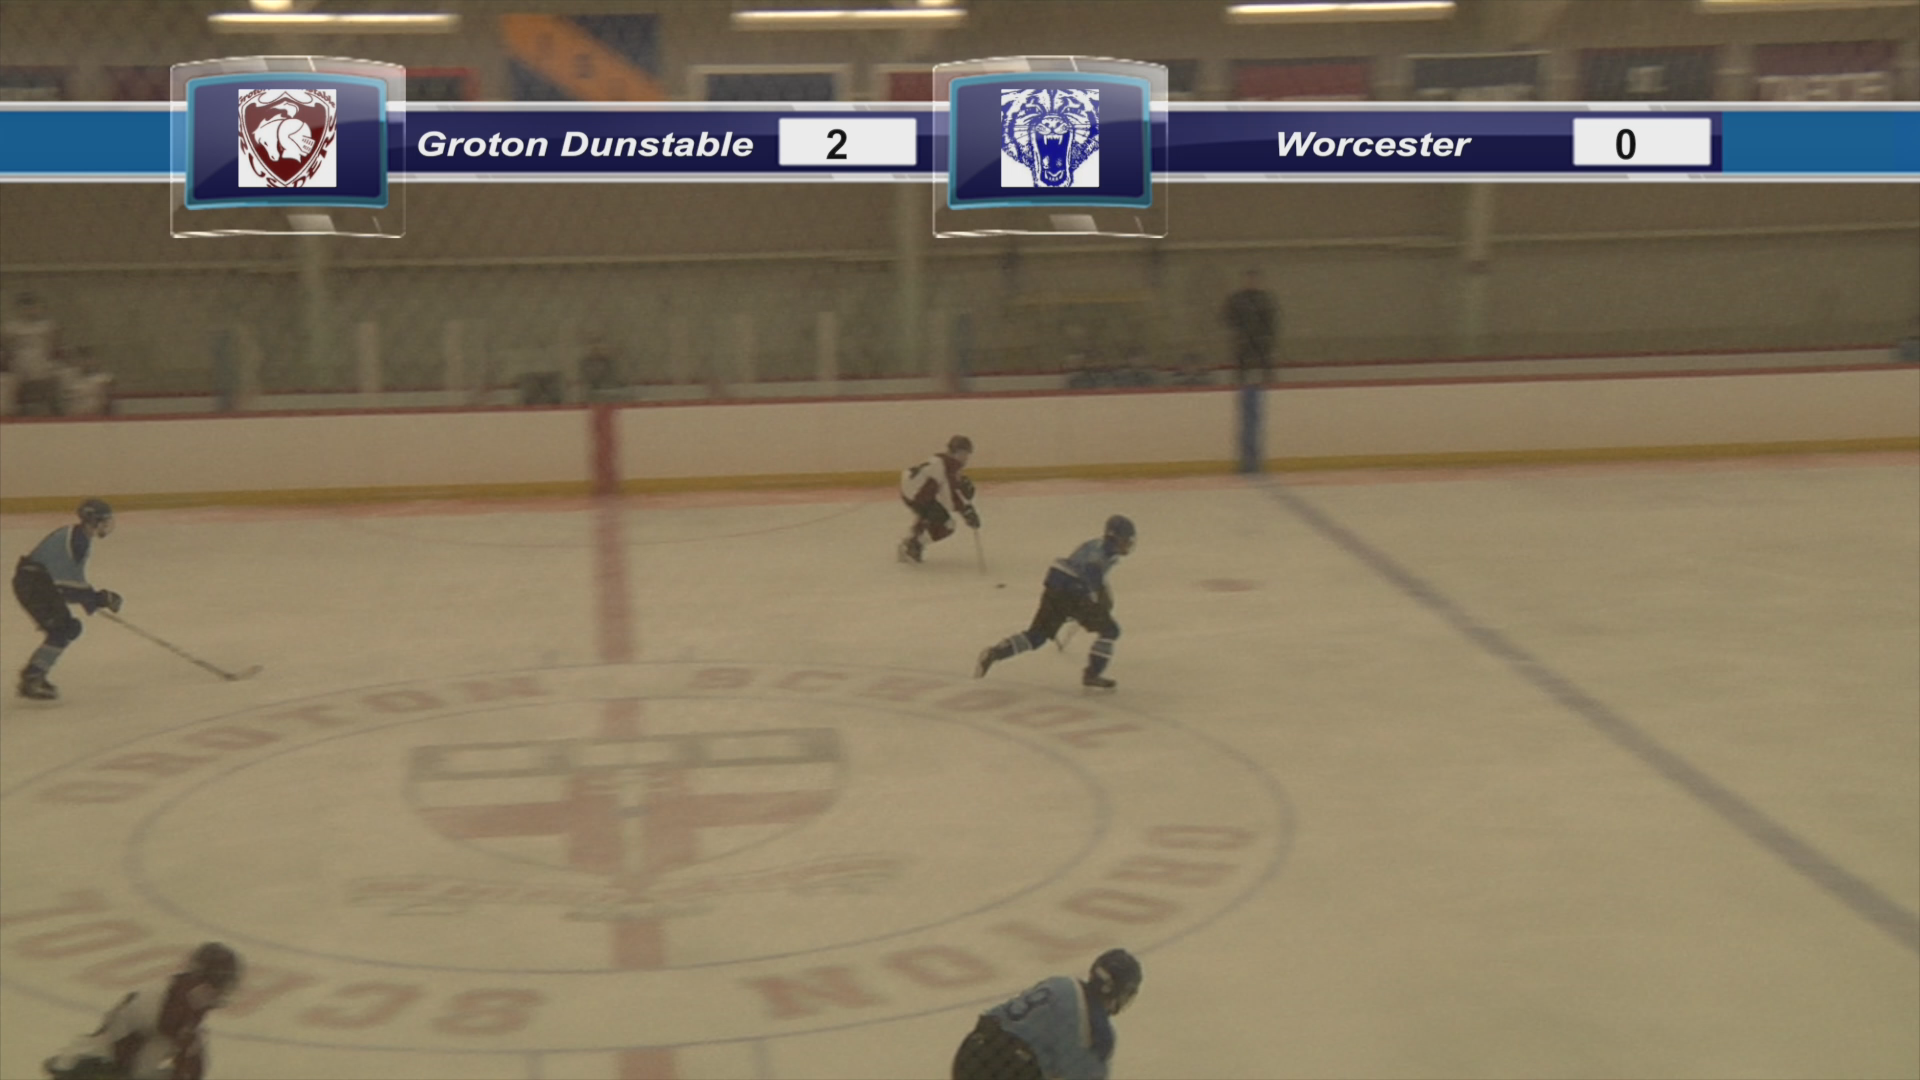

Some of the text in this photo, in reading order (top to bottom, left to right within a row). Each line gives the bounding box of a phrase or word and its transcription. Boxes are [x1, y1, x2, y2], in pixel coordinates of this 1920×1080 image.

[35, 667, 1142, 803] GROTON SCHOOL
[745, 822, 1256, 1021] GROTON
